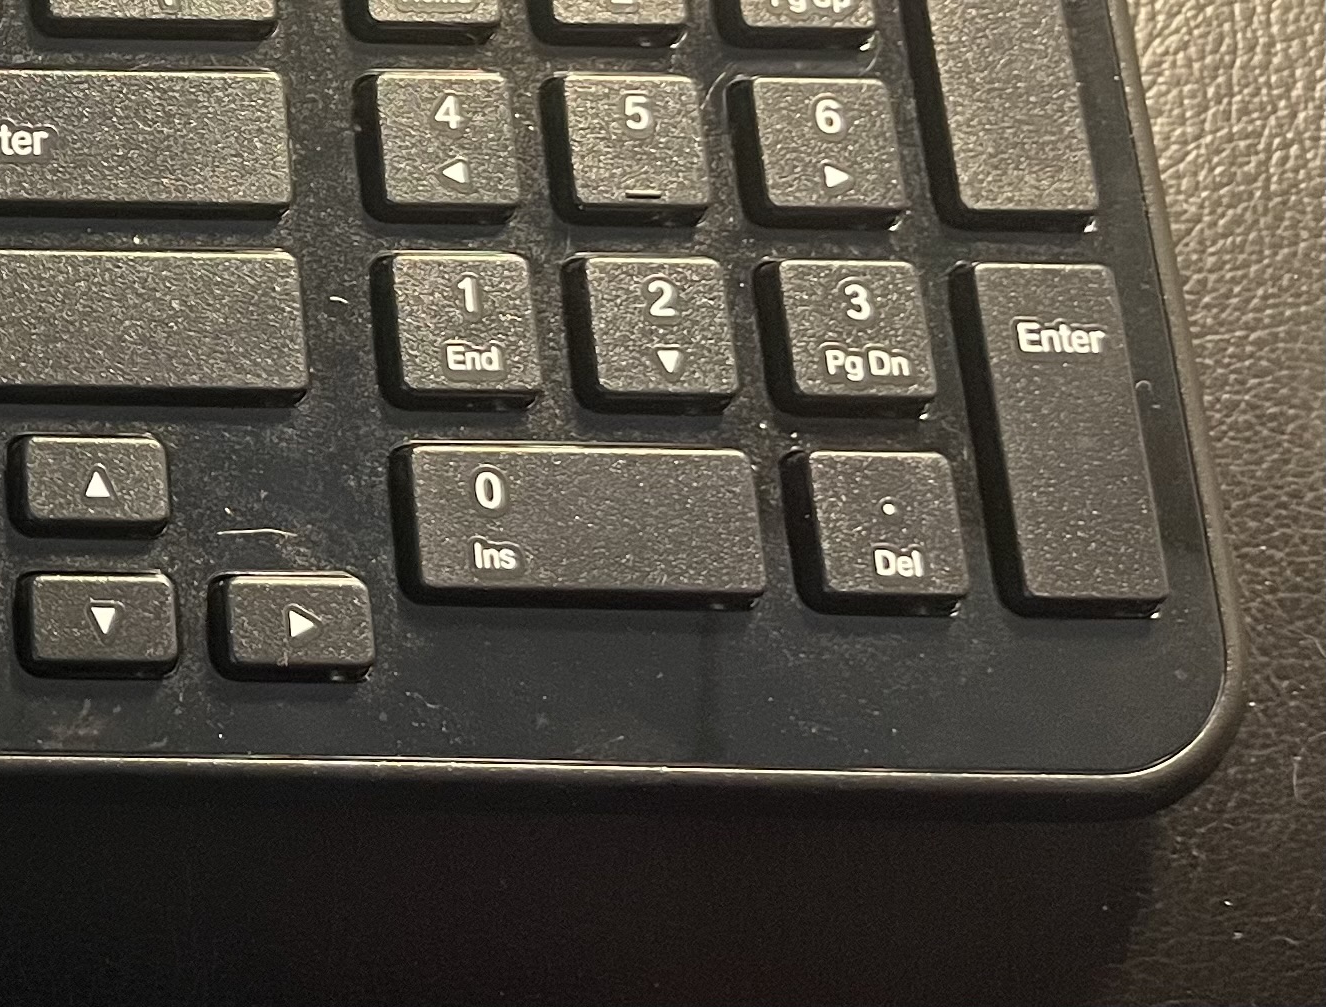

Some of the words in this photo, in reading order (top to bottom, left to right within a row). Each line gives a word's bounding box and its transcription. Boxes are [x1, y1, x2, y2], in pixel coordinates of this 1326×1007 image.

[434, 94, 461, 128] 4
[625, 94, 651, 129] 5
[816, 99, 842, 134] 6
[456, 277, 476, 312] 1
[648, 282, 677, 317] 2
[845, 284, 871, 320] 3
[1017, 323, 1105, 354] Enter
[447, 345, 503, 373] End
[474, 472, 502, 509] 0
[473, 542, 517, 570] Ins
[875, 548, 923, 578] Del
